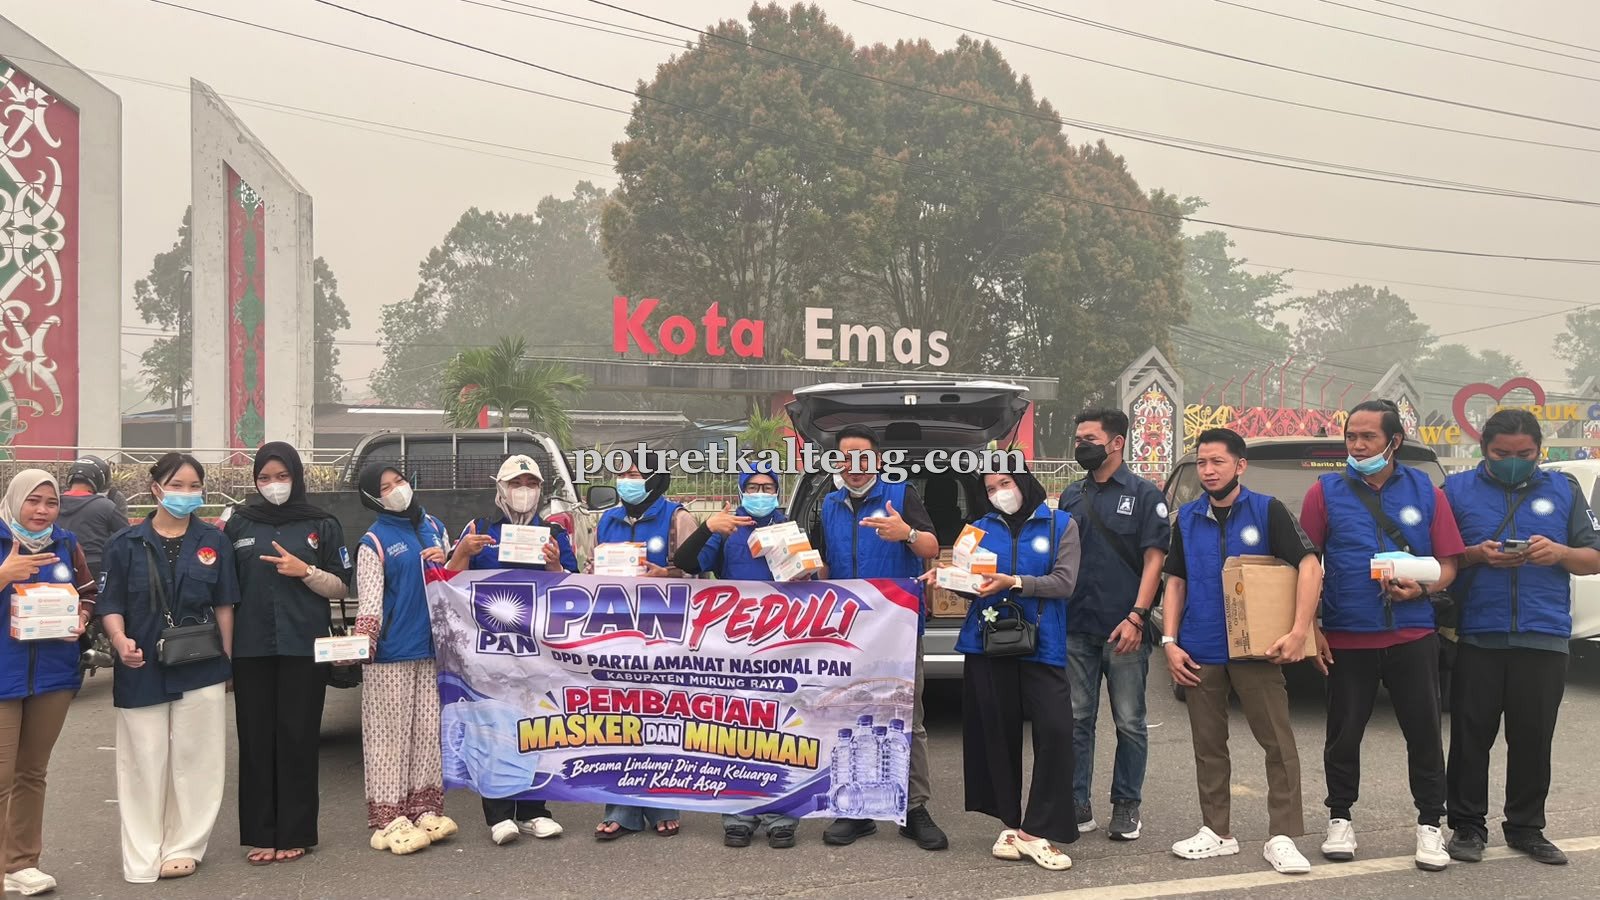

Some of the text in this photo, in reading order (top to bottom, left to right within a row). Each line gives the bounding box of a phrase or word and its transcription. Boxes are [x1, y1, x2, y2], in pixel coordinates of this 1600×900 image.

[612, 296, 950, 366] Kota Emas
[1495, 404, 1581, 420] RUK
[1418, 425, 1461, 445] we
[544, 584, 860, 651] PAN PEDULI
[479, 632, 535, 653] PAN
[551, 650, 852, 677] DPD PARTAI AMANAT NASIONAL PAN
[606, 671, 785, 690] KABUPATEN MURUNG RAYA
[563, 686, 778, 730] PEMBAGIAN
[517, 713, 820, 769] MASKER DAN MINUMAN
[570, 757, 778, 787] Bersama Lindungi Diri dan Keluarga
[617, 773, 727, 797] dari Kabut Asap
